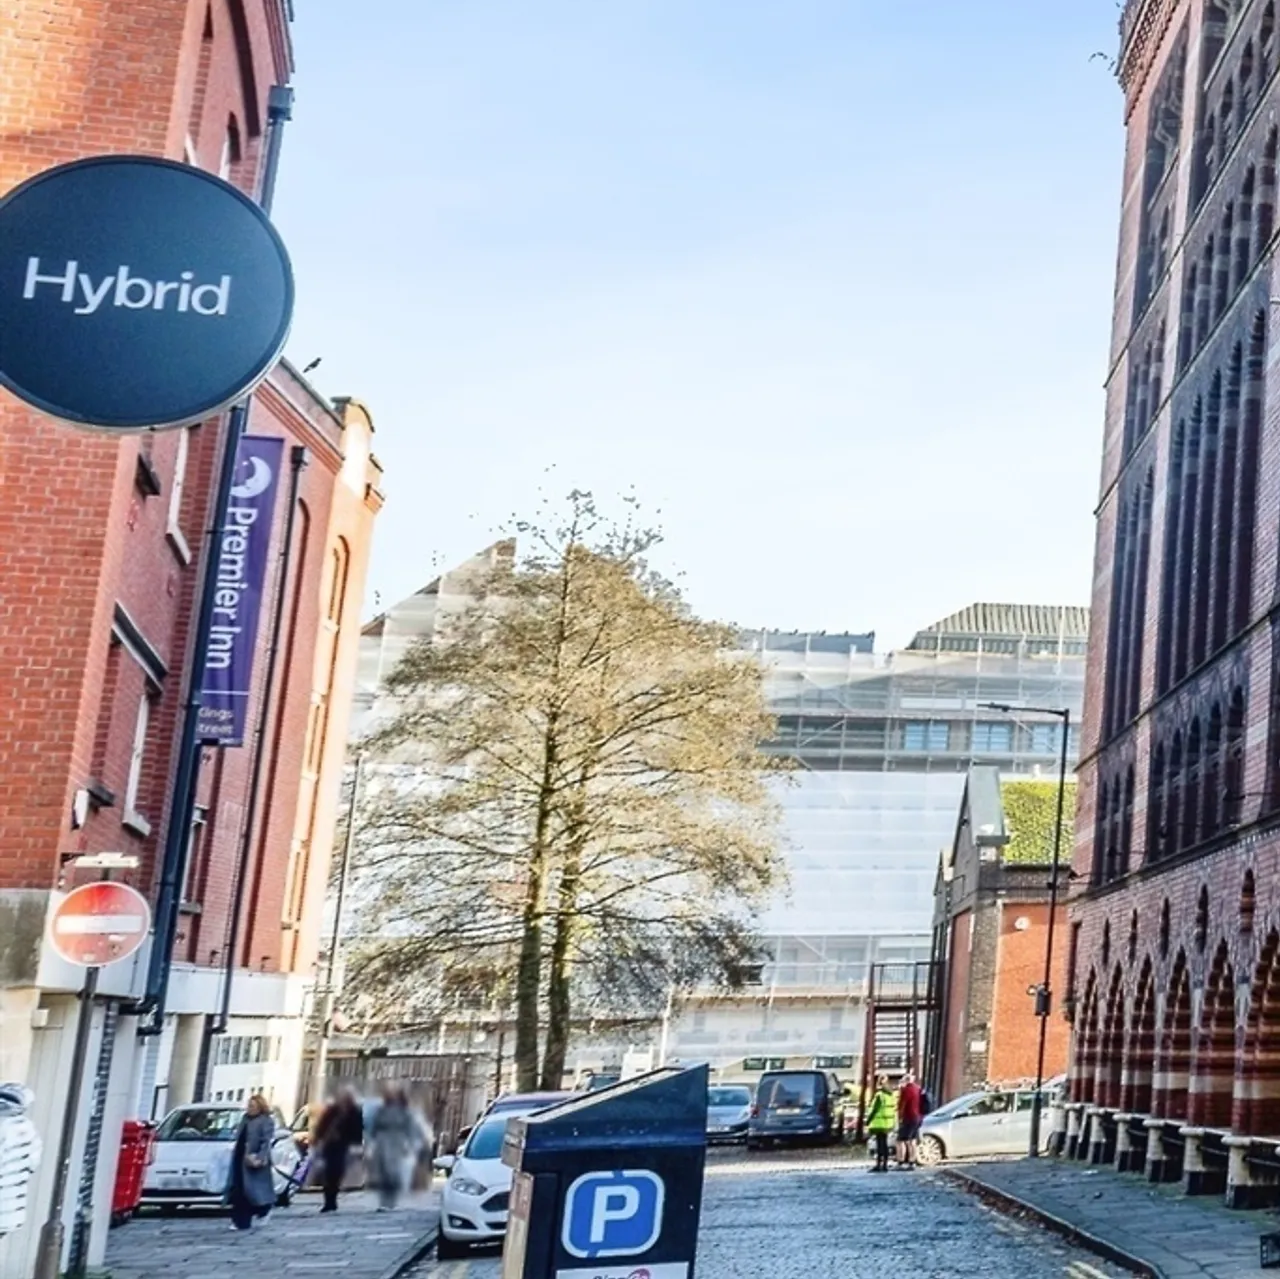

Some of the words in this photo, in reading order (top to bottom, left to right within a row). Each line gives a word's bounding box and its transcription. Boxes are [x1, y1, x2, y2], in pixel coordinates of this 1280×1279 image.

[23, 256, 231, 315] Hybrid
[213, 506, 259, 619] Premier
[205, 625, 242, 669] Inn
[590, 1185, 640, 1243] P
